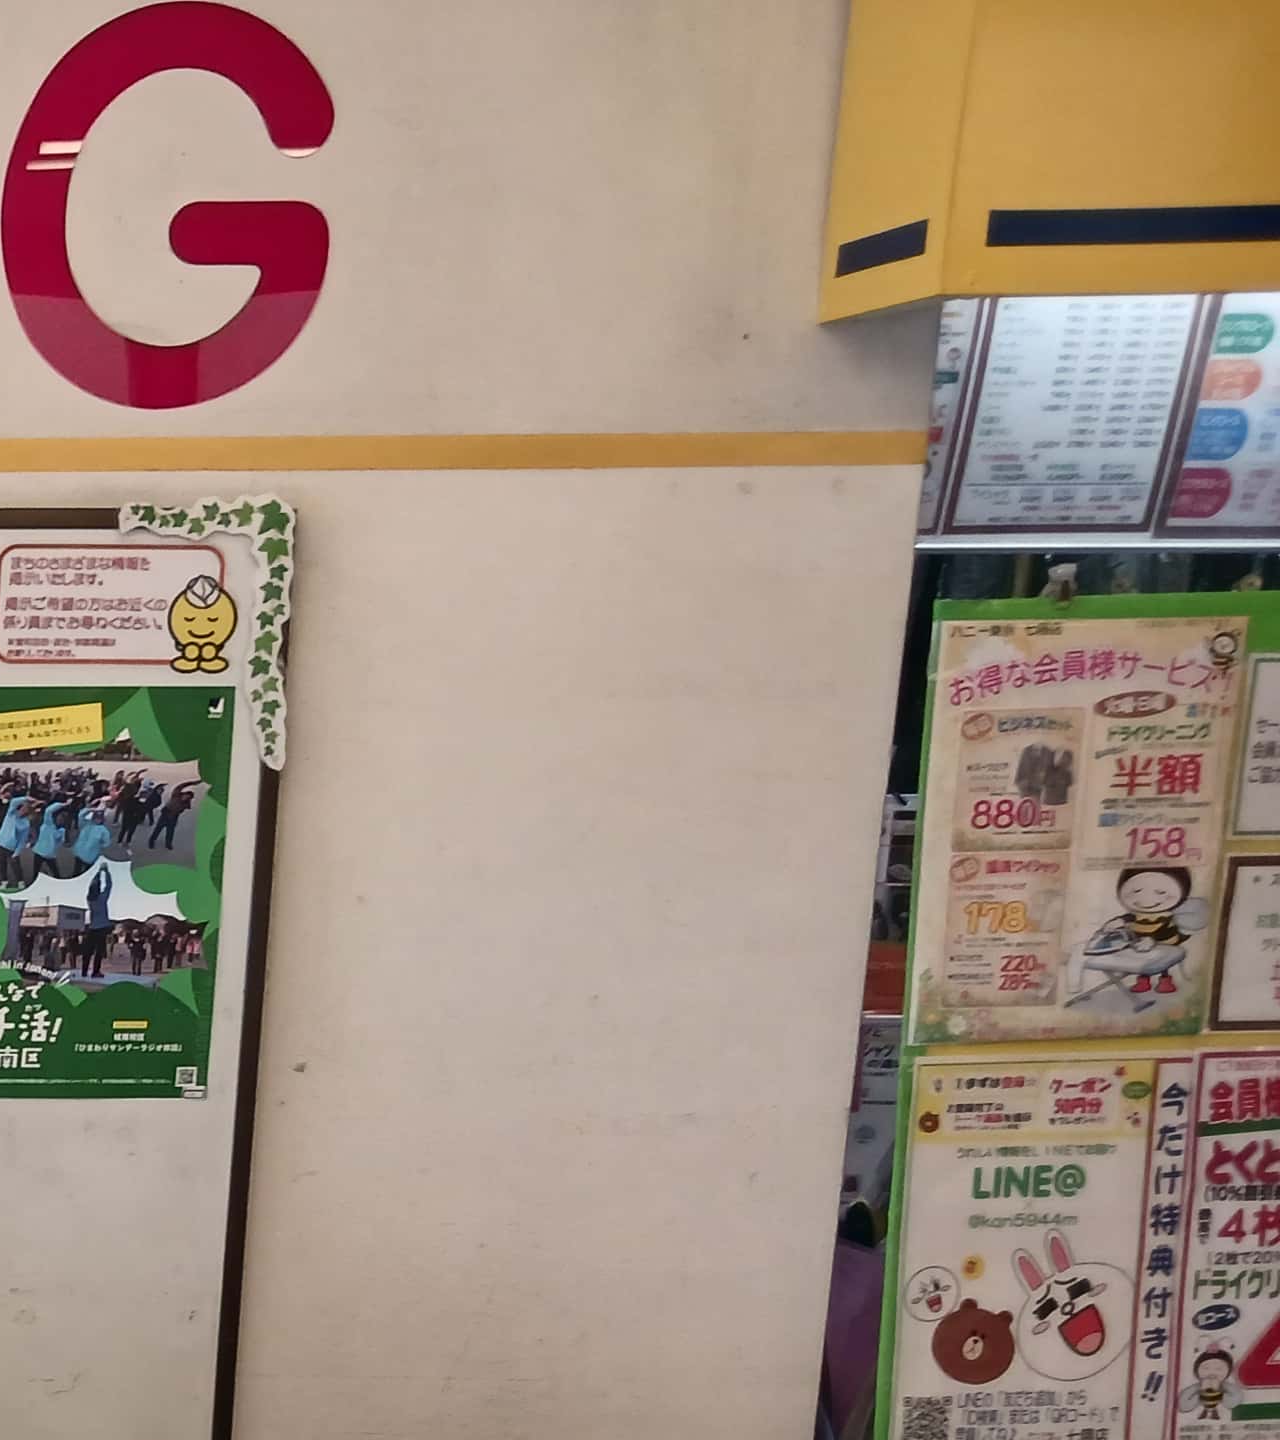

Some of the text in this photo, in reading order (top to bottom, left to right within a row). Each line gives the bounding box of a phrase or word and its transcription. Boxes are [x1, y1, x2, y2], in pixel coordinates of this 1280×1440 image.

[1108, 753, 1204, 797] 半額
[1049, 1076, 1112, 1094] クーポン
[971, 1163, 1087, 1200] LINE@
